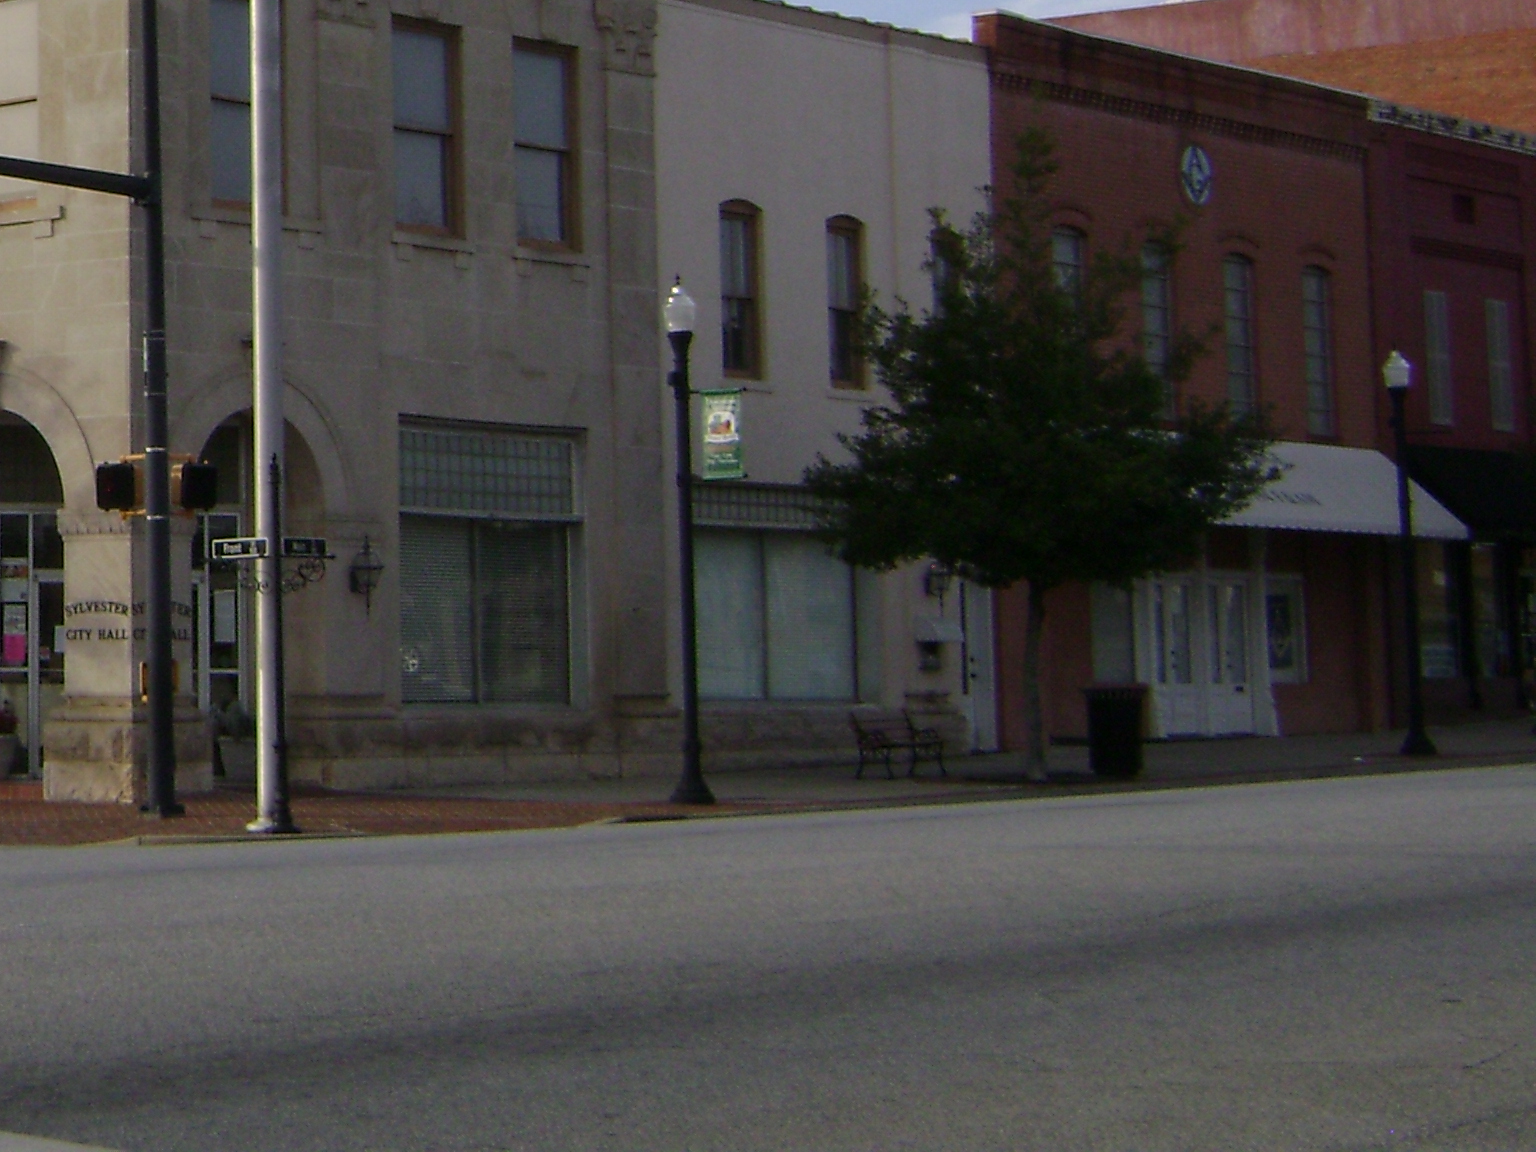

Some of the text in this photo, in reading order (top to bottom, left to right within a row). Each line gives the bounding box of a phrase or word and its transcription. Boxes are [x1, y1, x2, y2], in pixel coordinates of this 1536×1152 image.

[65, 601, 129, 617] SYLVESTER
[132, 601, 192, 617] SYTER
[66, 628, 129, 640] CITY HALL
